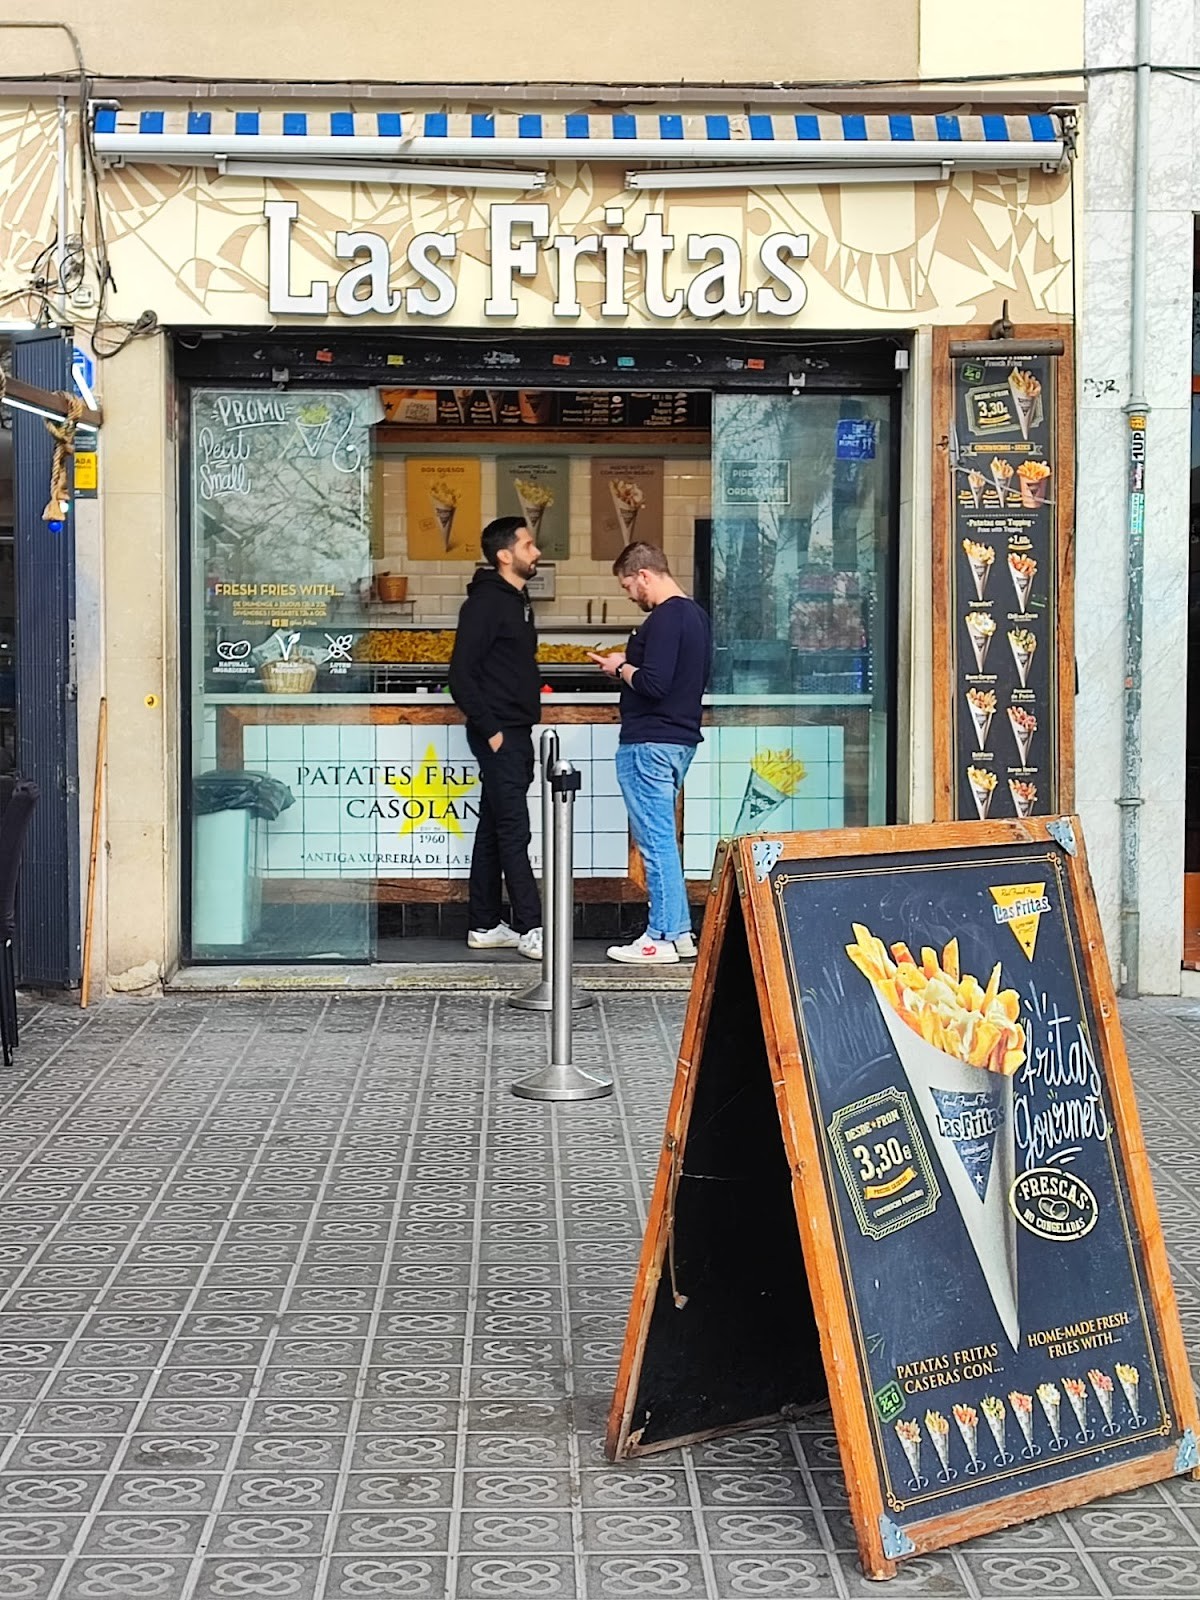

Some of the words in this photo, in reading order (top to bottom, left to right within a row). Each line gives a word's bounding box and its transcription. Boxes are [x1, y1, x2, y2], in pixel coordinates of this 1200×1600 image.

[264, 200, 457, 316] Las
[484, 203, 809, 318] Fritas
[1133, 432, 1144, 459] 1UP
[200, 463, 251, 499] Small
[215, 584, 258, 596] FRESH
[260, 584, 297, 596] FRIES
[300, 584, 345, 596] WITH...
[297, 766, 412, 786] PATATES
[346, 799, 482, 819] CASOLAN
[419, 834, 445, 844] 1960
[306, 853, 356, 864] ANTIGA
[358, 853, 421, 864] XURRERIA
[425, 853, 443, 864] DE
[994, 904, 1015, 922] Las
[1015, 897, 1049, 917] Fritas
[1020, 1002, 1102, 1097] fritas
[844, 1122, 873, 1142] DESDE
[876, 1109, 901, 1129] FROM
[935, 1113, 961, 1139] Las
[962, 1105, 1006, 1139] Fritas
[1020, 1175, 1089, 1210] FRESCAS
[1023, 1208, 1036, 1224] NO
[1036, 1217, 1086, 1234] CONGELADAS
[1027, 1319, 1097, 1348] HOME-MADE
[1096, 1311, 1130, 1331] FRESH
[1048, 1340, 1080, 1359] FRIES
[1080, 1331, 1122, 1350] WITH...
[896, 1354, 950, 1380] PATATAS
[953, 1342, 999, 1366] FRITAS
[904, 1368, 961, 1394] CASERAS
[963, 1361, 1005, 1380] CON...
